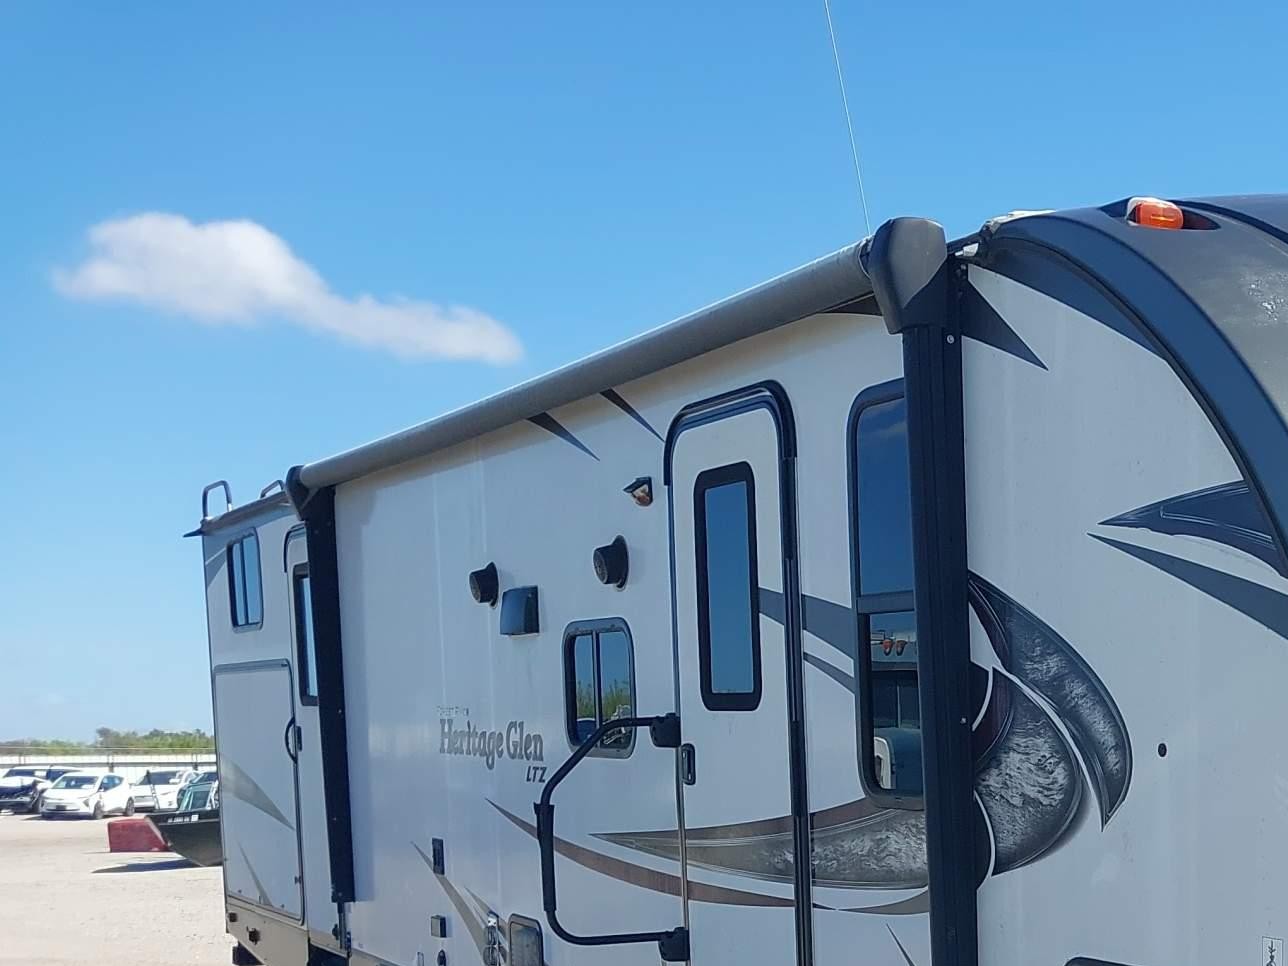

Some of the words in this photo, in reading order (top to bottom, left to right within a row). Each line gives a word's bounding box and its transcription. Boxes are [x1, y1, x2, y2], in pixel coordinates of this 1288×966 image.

[439, 718, 505, 771] Heritage
[505, 719, 544, 762] Glen
[525, 765, 548, 784] LTZ
